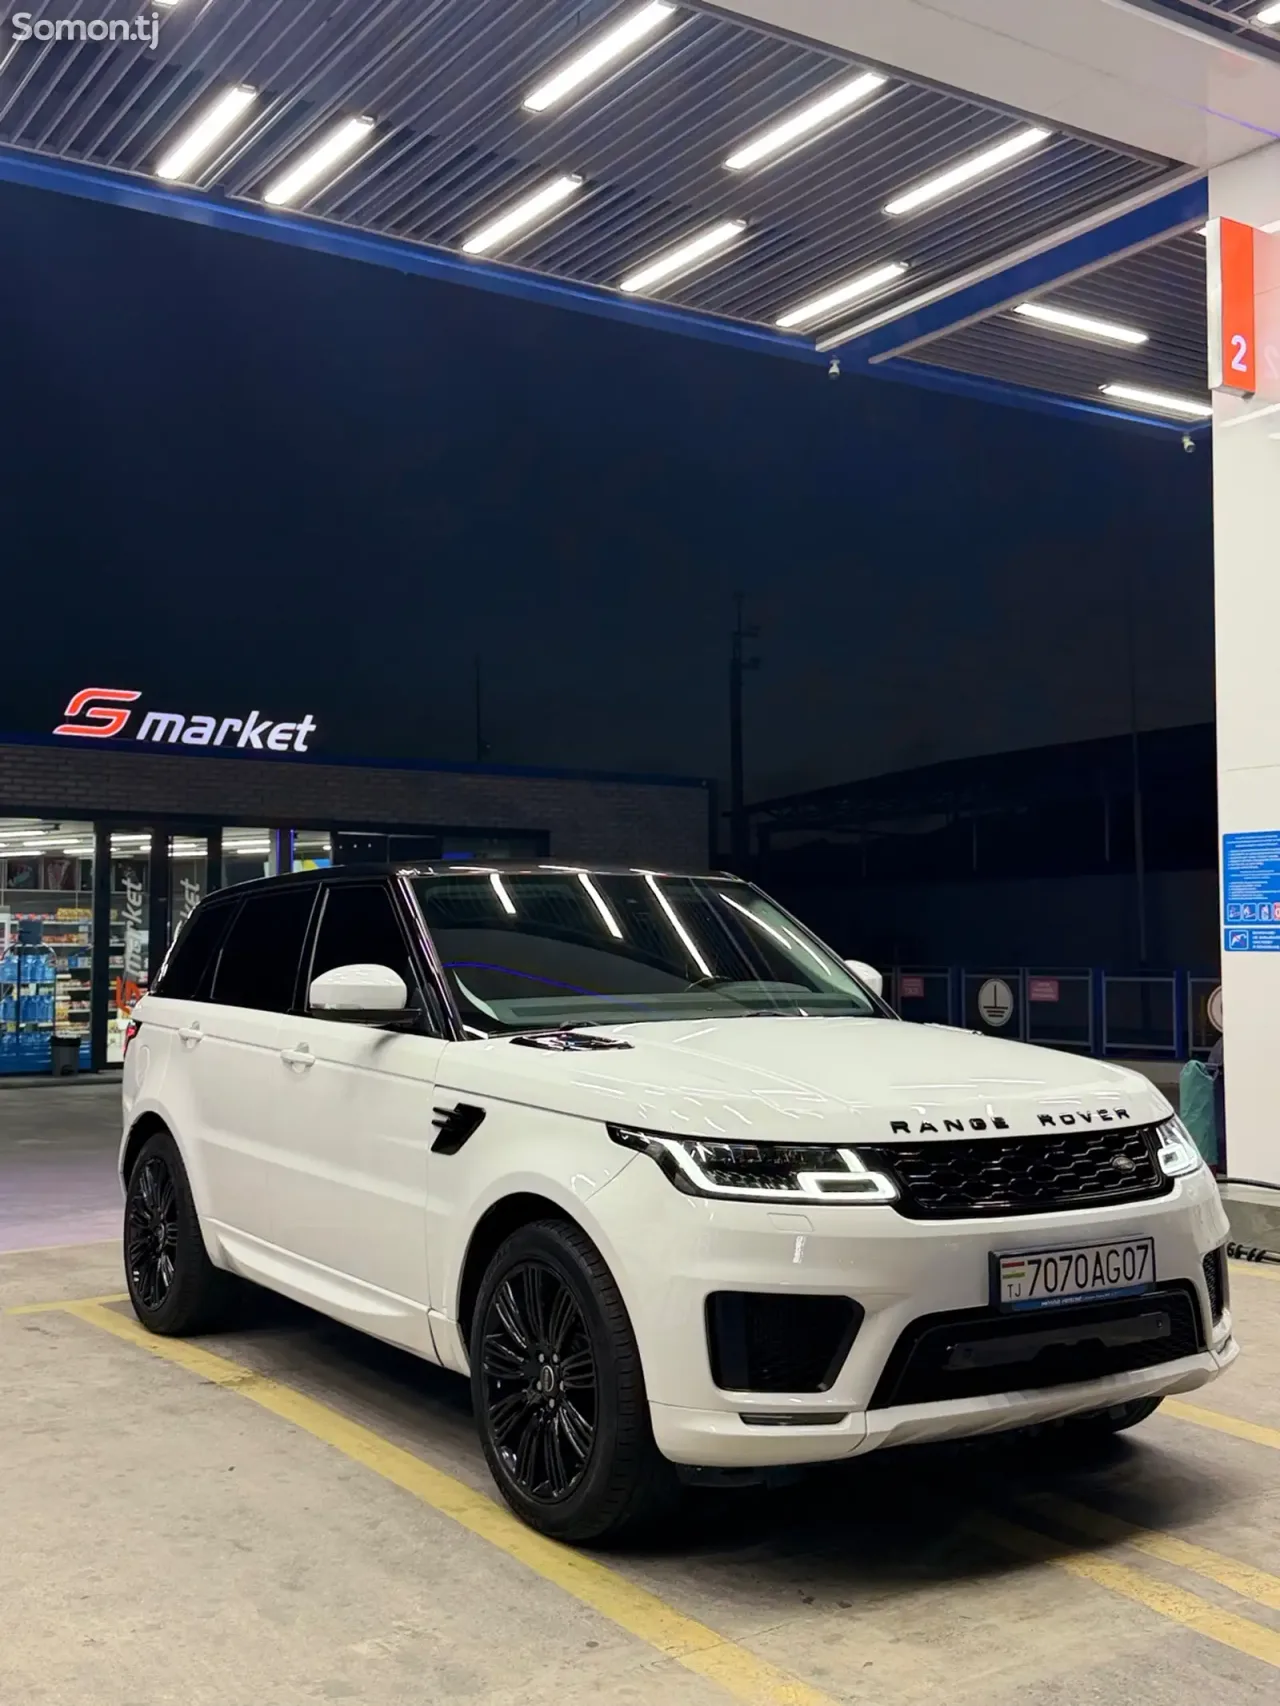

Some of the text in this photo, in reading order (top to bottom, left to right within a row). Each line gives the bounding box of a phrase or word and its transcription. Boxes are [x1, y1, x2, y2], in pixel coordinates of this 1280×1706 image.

[1231, 334, 1247, 372] 2
[136, 710, 317, 752] market
[121, 877, 143, 977] market
[890, 1107, 1131, 1134] RANGE ROVER
[1007, 1283, 1022, 1298] TJ
[1027, 1244, 1149, 1297] 7070AG07
